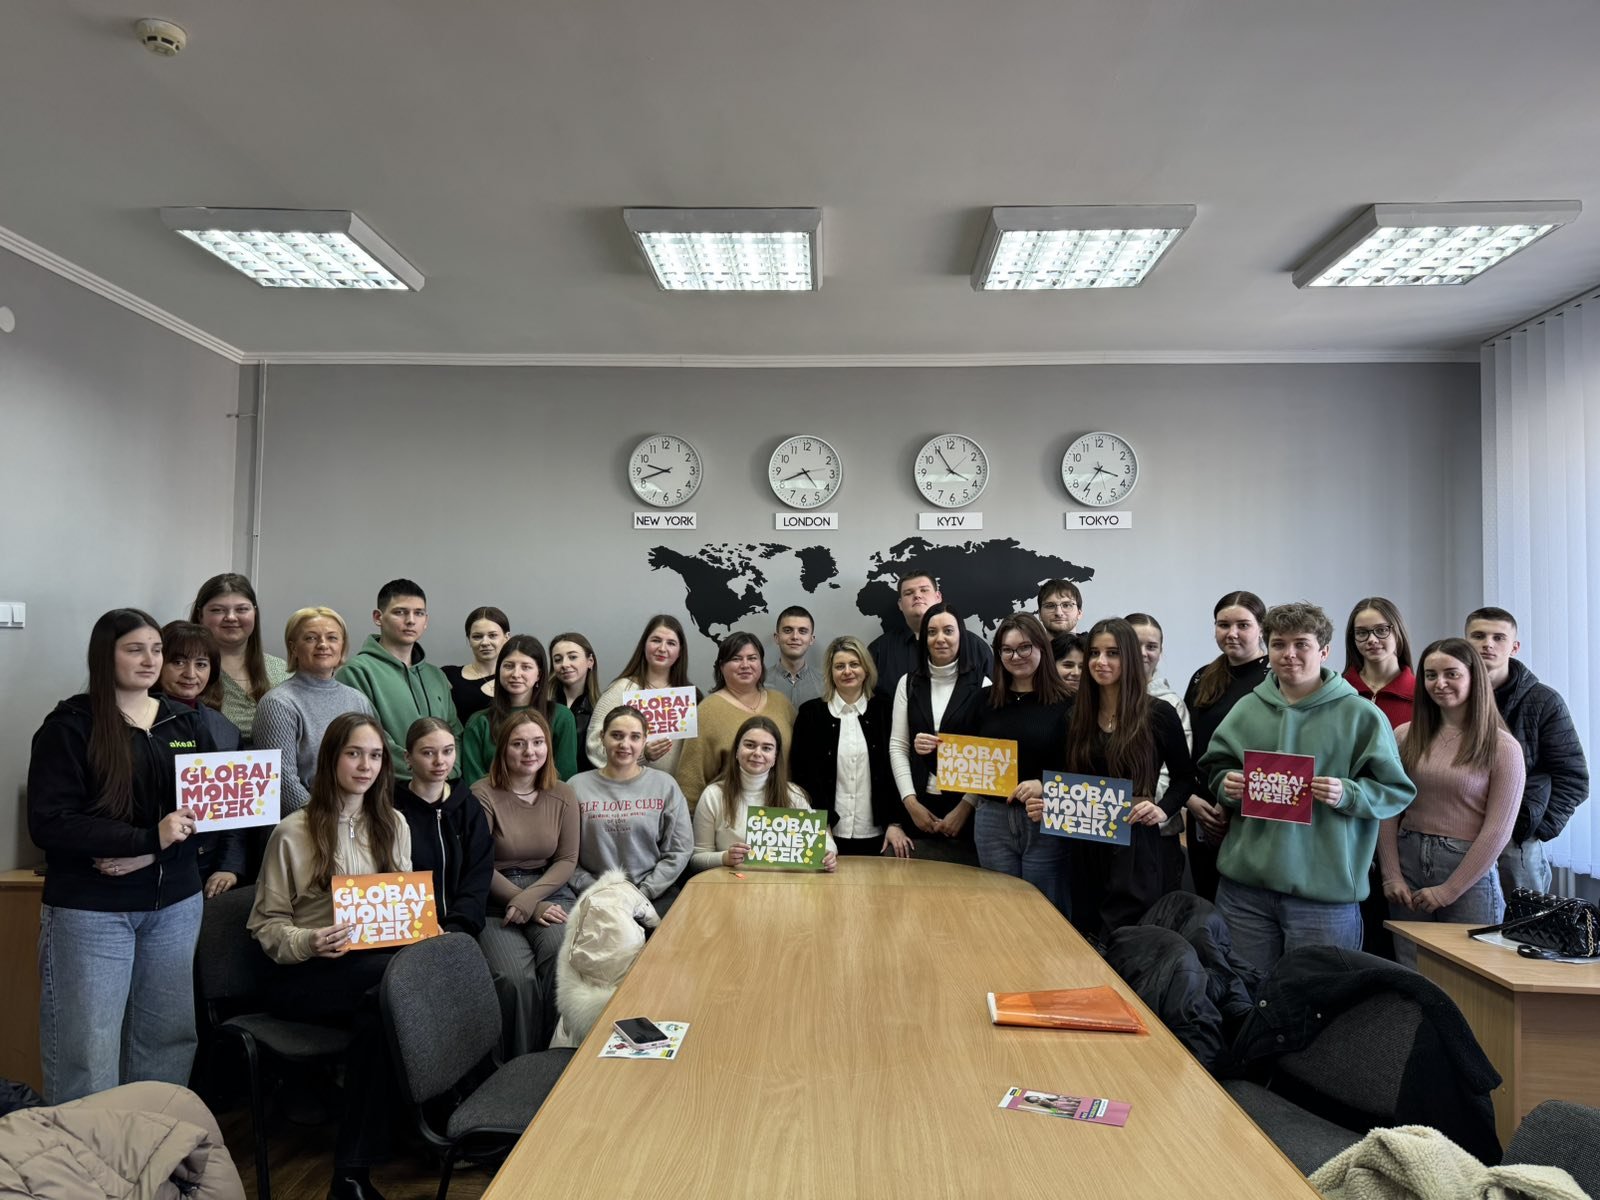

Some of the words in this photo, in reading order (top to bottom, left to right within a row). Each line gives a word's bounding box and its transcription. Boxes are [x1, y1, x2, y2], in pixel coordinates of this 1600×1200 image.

[662, 440, 670, 449] 12
[803, 442, 811, 451] 12
[947, 441, 955, 449] 12
[1083, 444, 1088, 452] 11
[1095, 439, 1104, 448] 12
[650, 445, 656, 454] 11
[791, 446, 797, 454] 11
[640, 454, 649, 463] 10
[685, 453, 691, 462] 2
[782, 455, 789, 463] 10
[926, 456, 934, 464] 10
[971, 452, 976, 461] 2
[1073, 453, 1081, 462] 10
[1120, 451, 1126, 460] 2
[826, 456, 831, 465] 2
[636, 467, 641, 475] 9
[690, 466, 695, 475] 3
[776, 467, 781, 475] 9
[921, 468, 927, 477] 9
[976, 465, 982, 475] 3
[1068, 466, 1074, 475] 9
[1124, 465, 1130, 474] 3
[829, 470, 835, 479] 3
[641, 480, 646, 488] 8
[685, 480, 691, 488] 4
[824, 483, 830, 491] 4
[926, 482, 932, 490] 8
[972, 480, 977, 488] 4
[1073, 479, 1079, 488] 8
[1120, 479, 1126, 488] 4
[676, 489, 682, 498] 5
[791, 490, 796, 498] 7
[814, 492, 820, 500] 5
[938, 490, 944, 499] 7
[963, 489, 968, 498] 5
[1097, 492, 1102, 501] 6
[1110, 488, 1116, 497] 5
[663, 493, 669, 502] 6
[801, 494, 806, 503] 6
[950, 493, 955, 502] 6
[636, 516, 660, 526] NEW
[664, 516, 694, 526] YORK
[783, 517, 831, 526] LONDON
[937, 517, 965, 526] KYIV
[1079, 515, 1120, 525] TOKYO
[642, 708, 689, 722] ONEY
[648, 720, 680, 734] EEK
[938, 743, 1016, 763] GLOBAL
[938, 757, 1010, 777] MONEY
[181, 762, 278, 785] GLOBAL
[937, 770, 996, 790] WEEK
[1249, 771, 1308, 786] GLOBAL
[182, 780, 270, 804] MONEY
[1249, 781, 1302, 795] MONEY
[1043, 781, 1131, 807] GLOBAL
[1248, 789, 1292, 805] WEEK
[580, 801, 599, 813] ELF
[603, 800, 631, 811] LOVE
[635, 799, 664, 810] CLUB
[1043, 798, 1122, 820] MONEY
[748, 816, 825, 834] GLOBAL
[1042, 812, 1107, 836] WEEK
[746, 831, 818, 848] MONEY
[748, 845, 804, 863] WEEK
[335, 883, 434, 906] GLOBAL
[335, 901, 425, 924] MONEY
